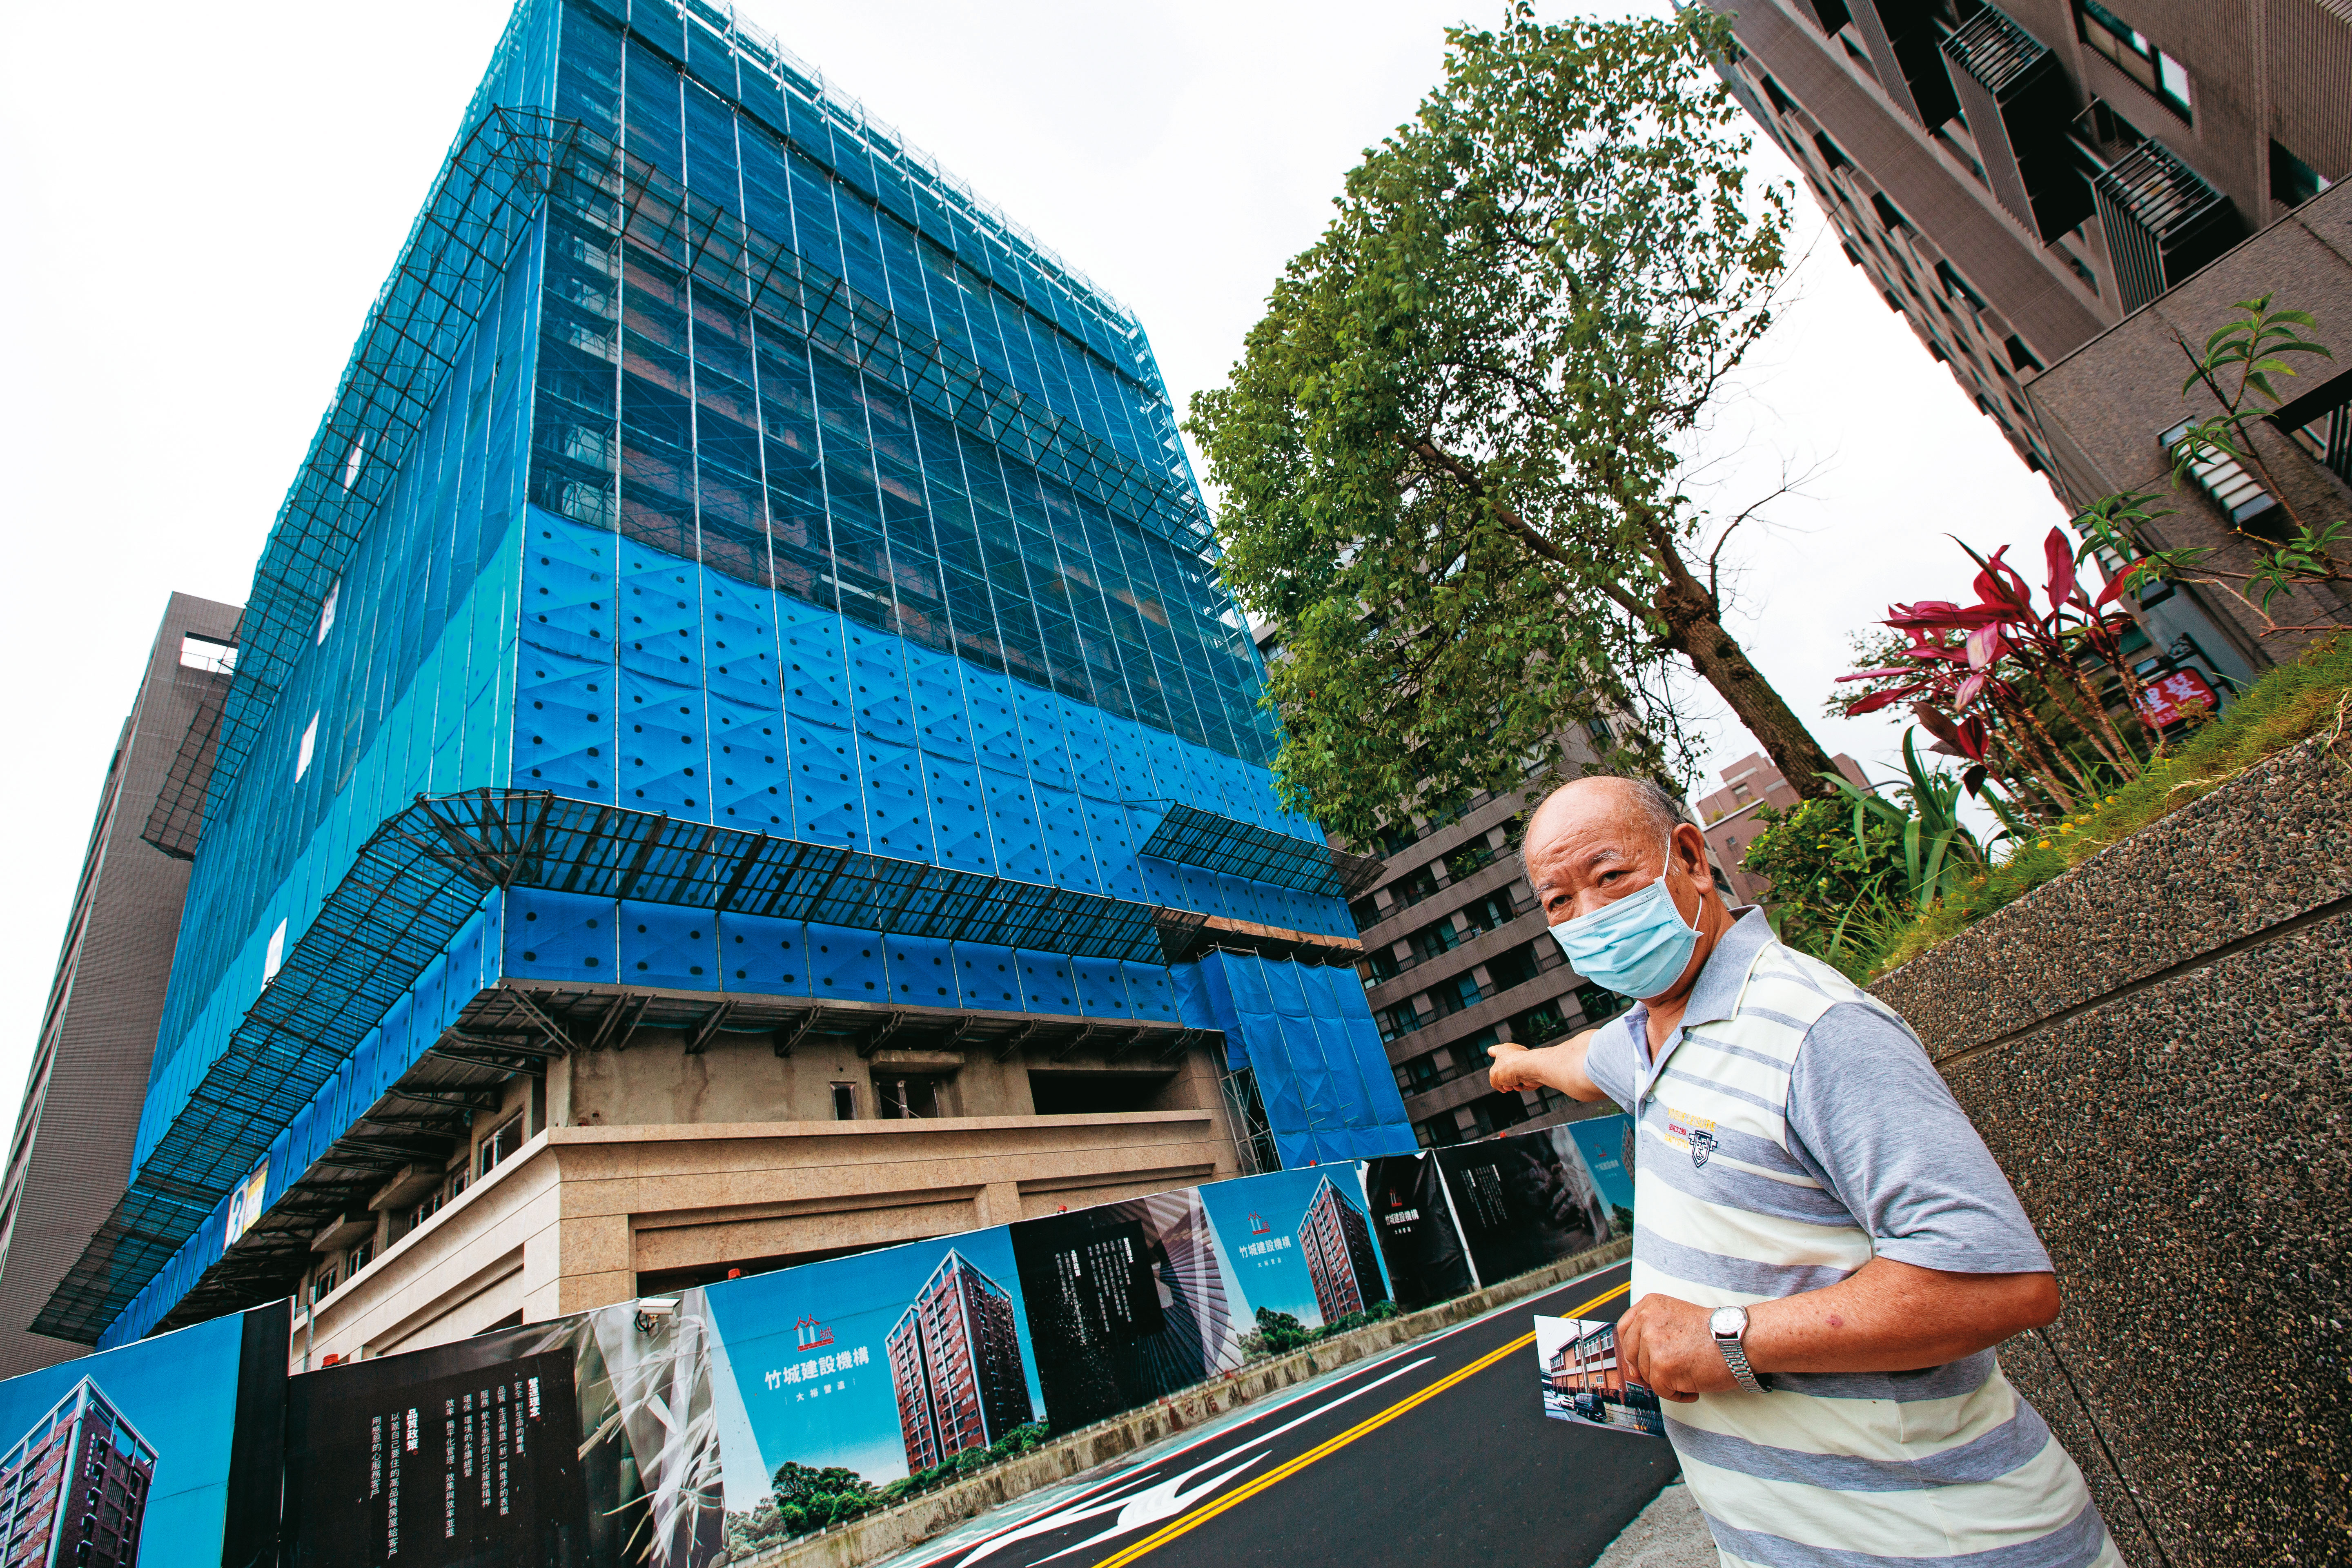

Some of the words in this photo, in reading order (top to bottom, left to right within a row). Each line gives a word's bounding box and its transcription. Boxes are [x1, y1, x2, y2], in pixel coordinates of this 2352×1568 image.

[1668, 1123, 1679, 1133] SINCE
[1686, 1114, 1716, 1132] LEISURE
[1239, 1235, 1291, 1258] 竹城建設機構
[764, 1345, 869, 1391] 竹城建設機構
[480, 1389, 489, 1408] 服務
[497, 1385, 506, 1403] 品質
[514, 1381, 523, 1399] 安全
[445, 1399, 455, 1416] 效率
[463, 1394, 472, 1412] 環保
[515, 1401, 524, 1454] 對生命的尊重
[370, 1416, 381, 1499] 用感恩的心服務客戶
